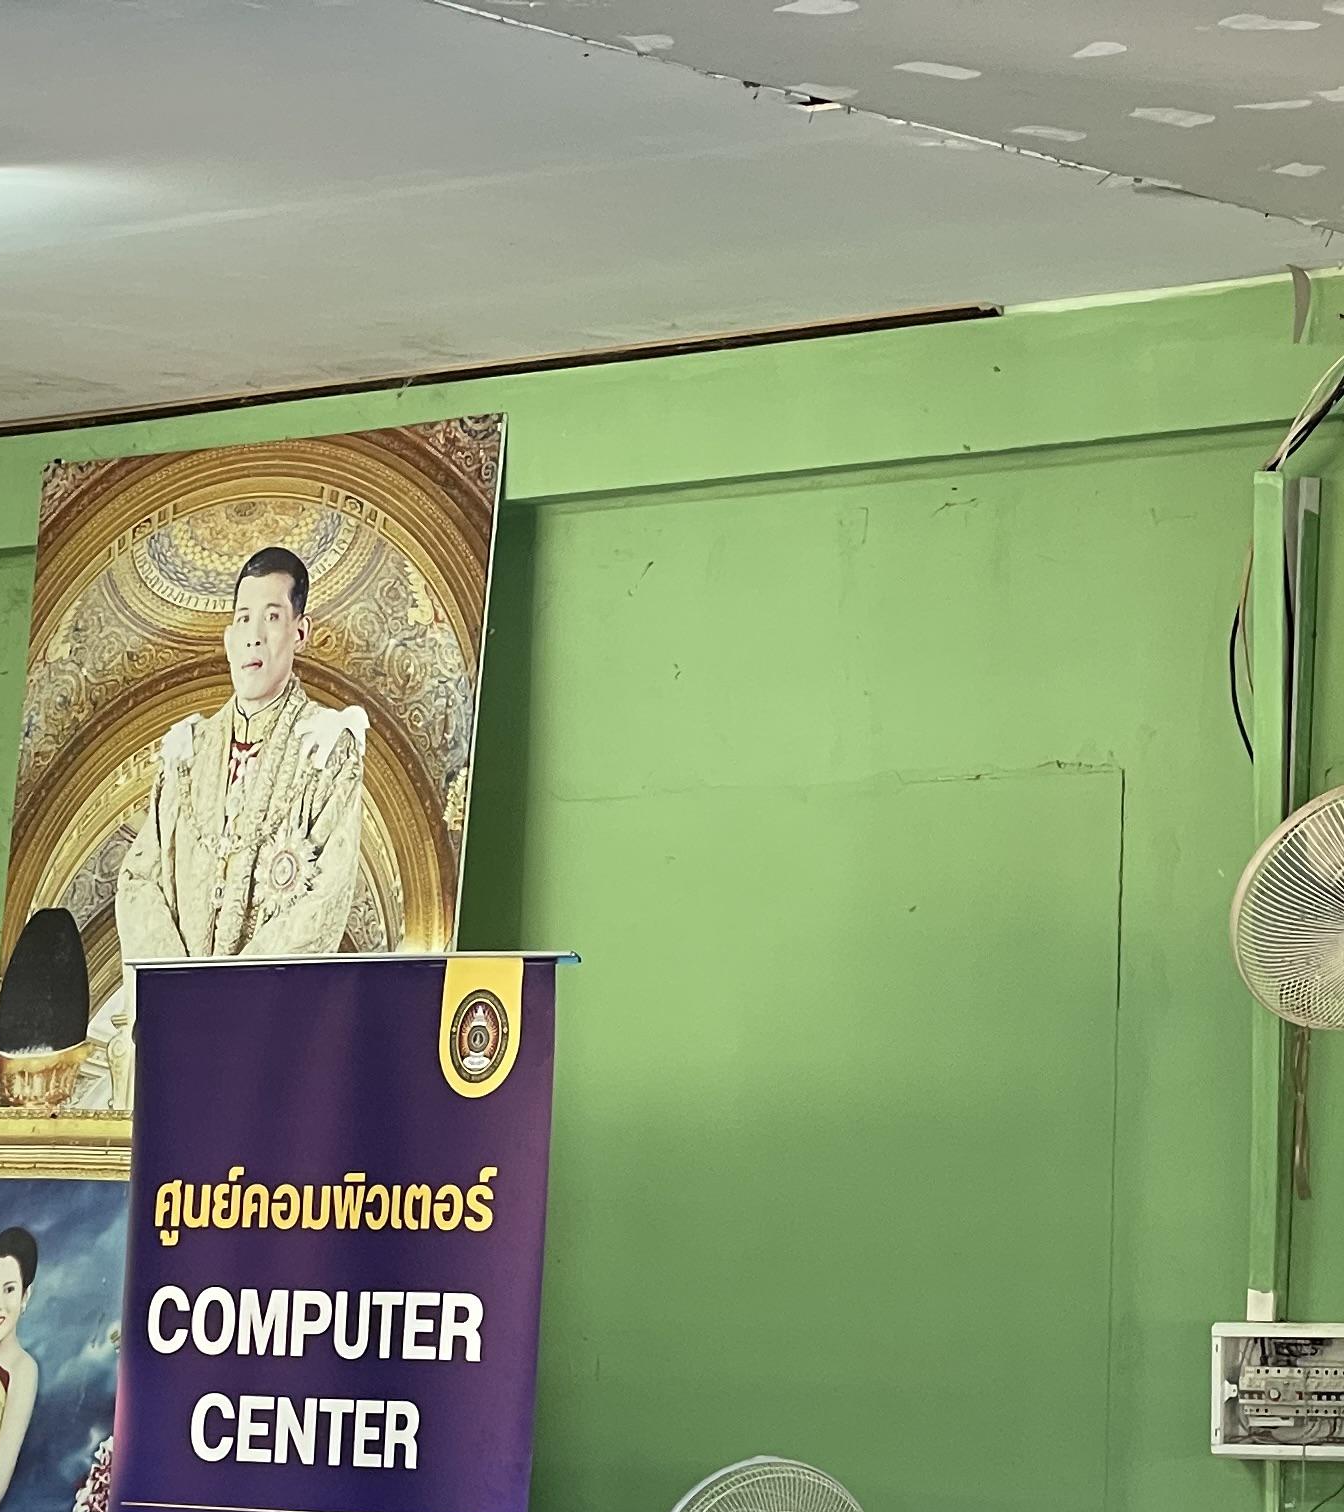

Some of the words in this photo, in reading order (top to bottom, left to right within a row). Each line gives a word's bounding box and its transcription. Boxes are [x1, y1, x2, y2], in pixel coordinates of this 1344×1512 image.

[154, 1167, 498, 1246] ศูนย์คอมพิวเตอร์
[147, 1285, 484, 1363] COMPUTER
[190, 1392, 420, 1470] CENTER
